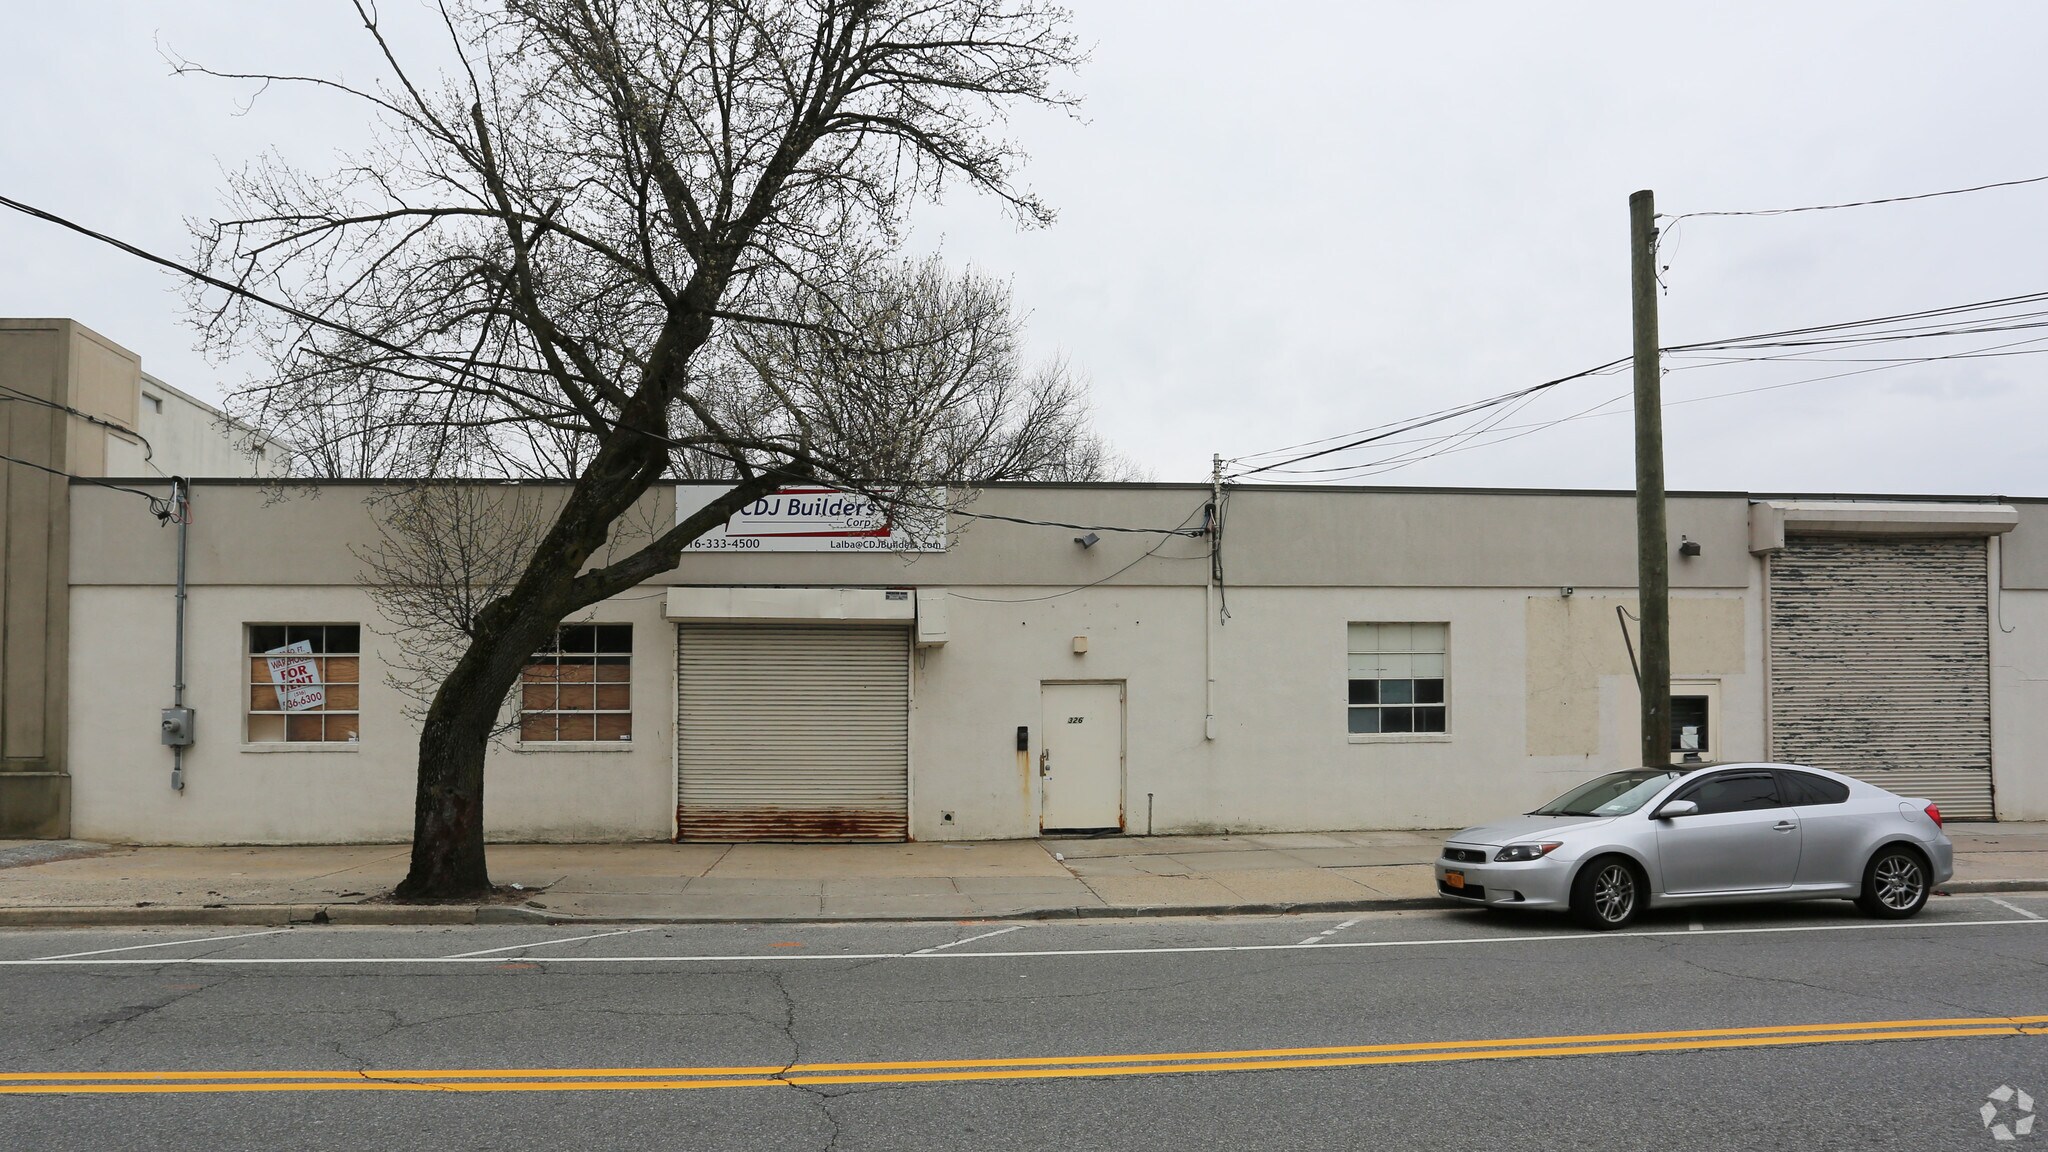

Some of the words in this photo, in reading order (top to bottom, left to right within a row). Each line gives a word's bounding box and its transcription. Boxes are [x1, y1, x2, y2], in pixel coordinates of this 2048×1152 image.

[740, 498, 780, 516] CDJ
[787, 498, 876, 516] Builders
[688, 539, 760, 549] 16-333-4500
[271, 652, 311, 669] WAREHOU
[280, 665, 307, 681] FOR
[1067, 716, 1084, 724] 326
